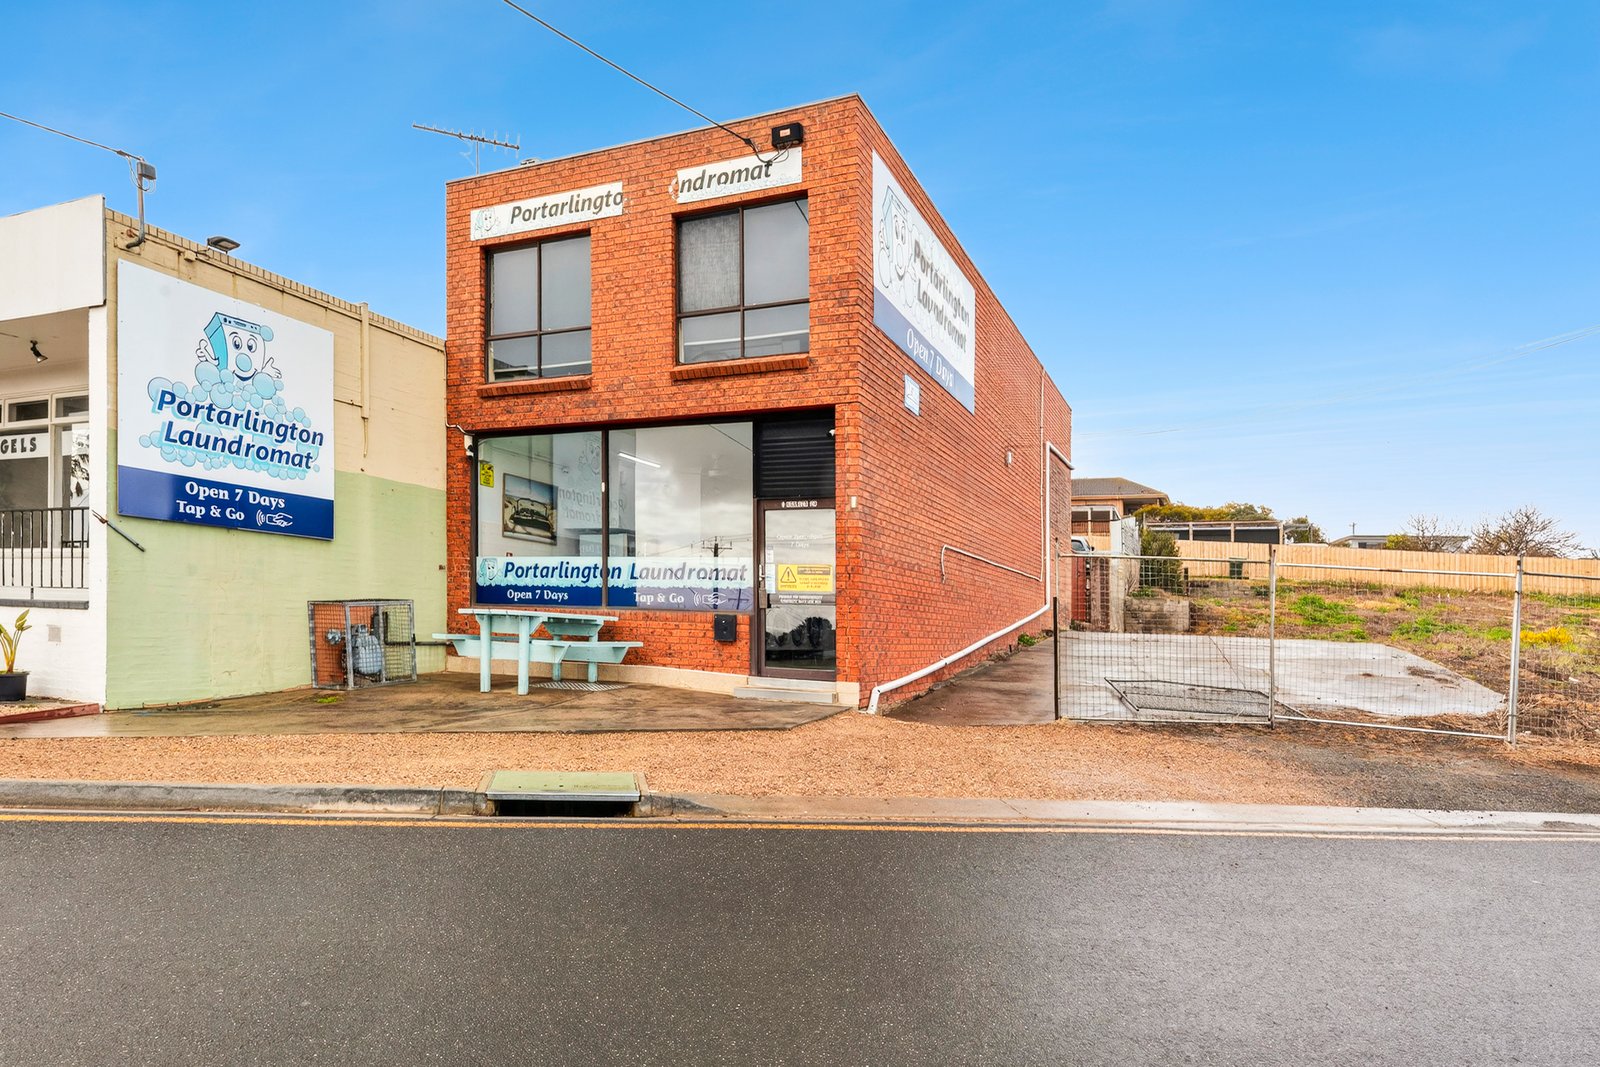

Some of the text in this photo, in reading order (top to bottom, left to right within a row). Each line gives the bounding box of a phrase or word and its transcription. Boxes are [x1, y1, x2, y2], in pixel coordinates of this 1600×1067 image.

[914, 239, 970, 328] Portarlington
[917, 279, 967, 354] Laundromat
[906, 328, 954, 387] Open 7 Days
[157, 389, 324, 446] Portarlington
[164, 421, 313, 470] Laundromat
[176, 500, 245, 521] Tap & Go
[185, 481, 285, 510] Open 7 Days
[629, 561, 747, 581] Laundromat
[507, 589, 569, 602] Open 7 Days
[633, 592, 684, 605] Tap & Go
